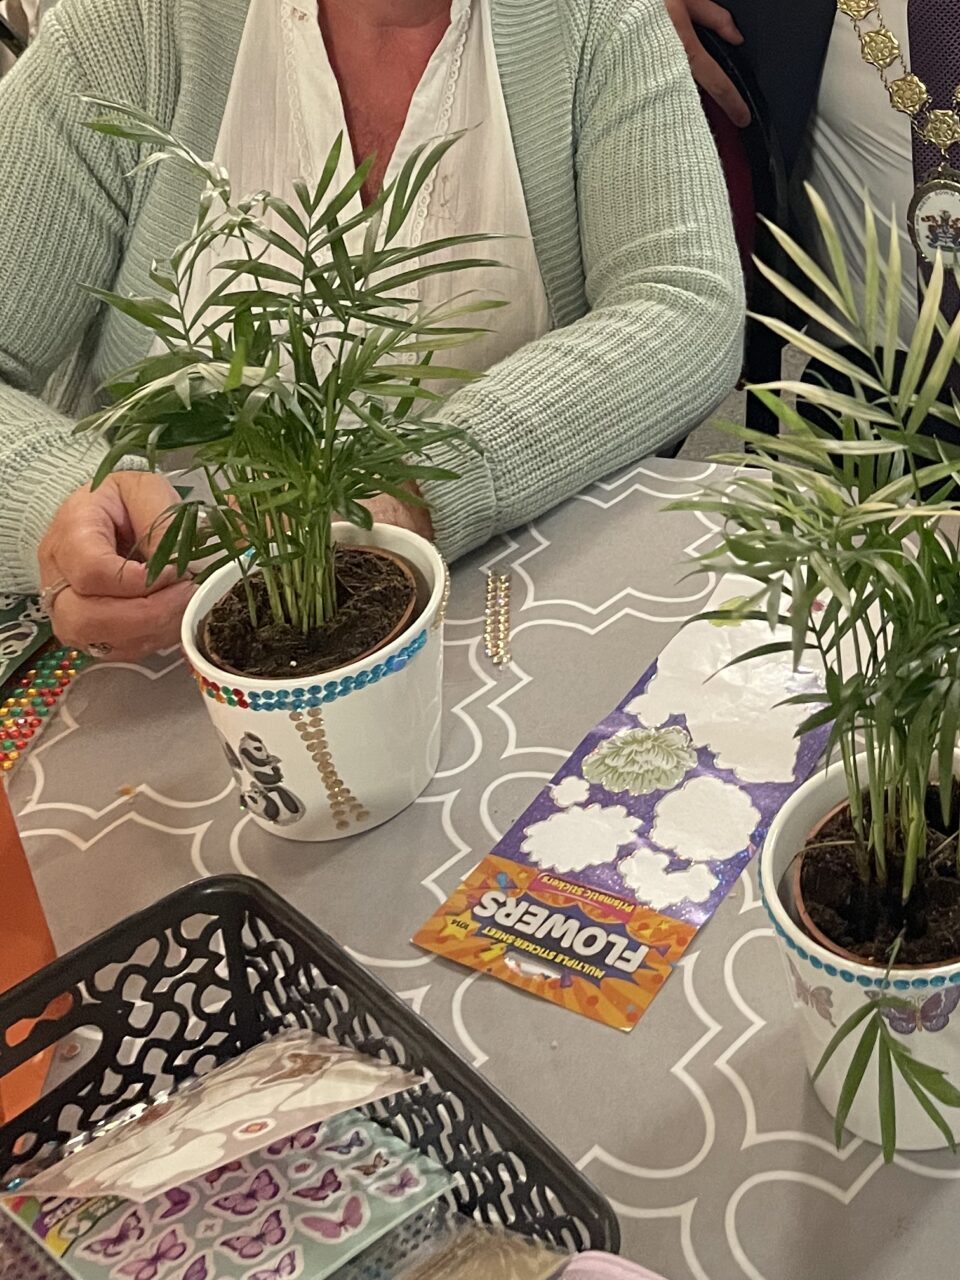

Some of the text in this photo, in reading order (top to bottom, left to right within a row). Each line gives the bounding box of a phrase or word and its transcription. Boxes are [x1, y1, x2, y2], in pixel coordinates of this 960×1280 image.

[541, 875, 635, 913] Prismatic Stickers
[473, 891, 649, 974] FLOWERS
[482, 926, 606, 979] MULTIPLE STICKER SHEET
